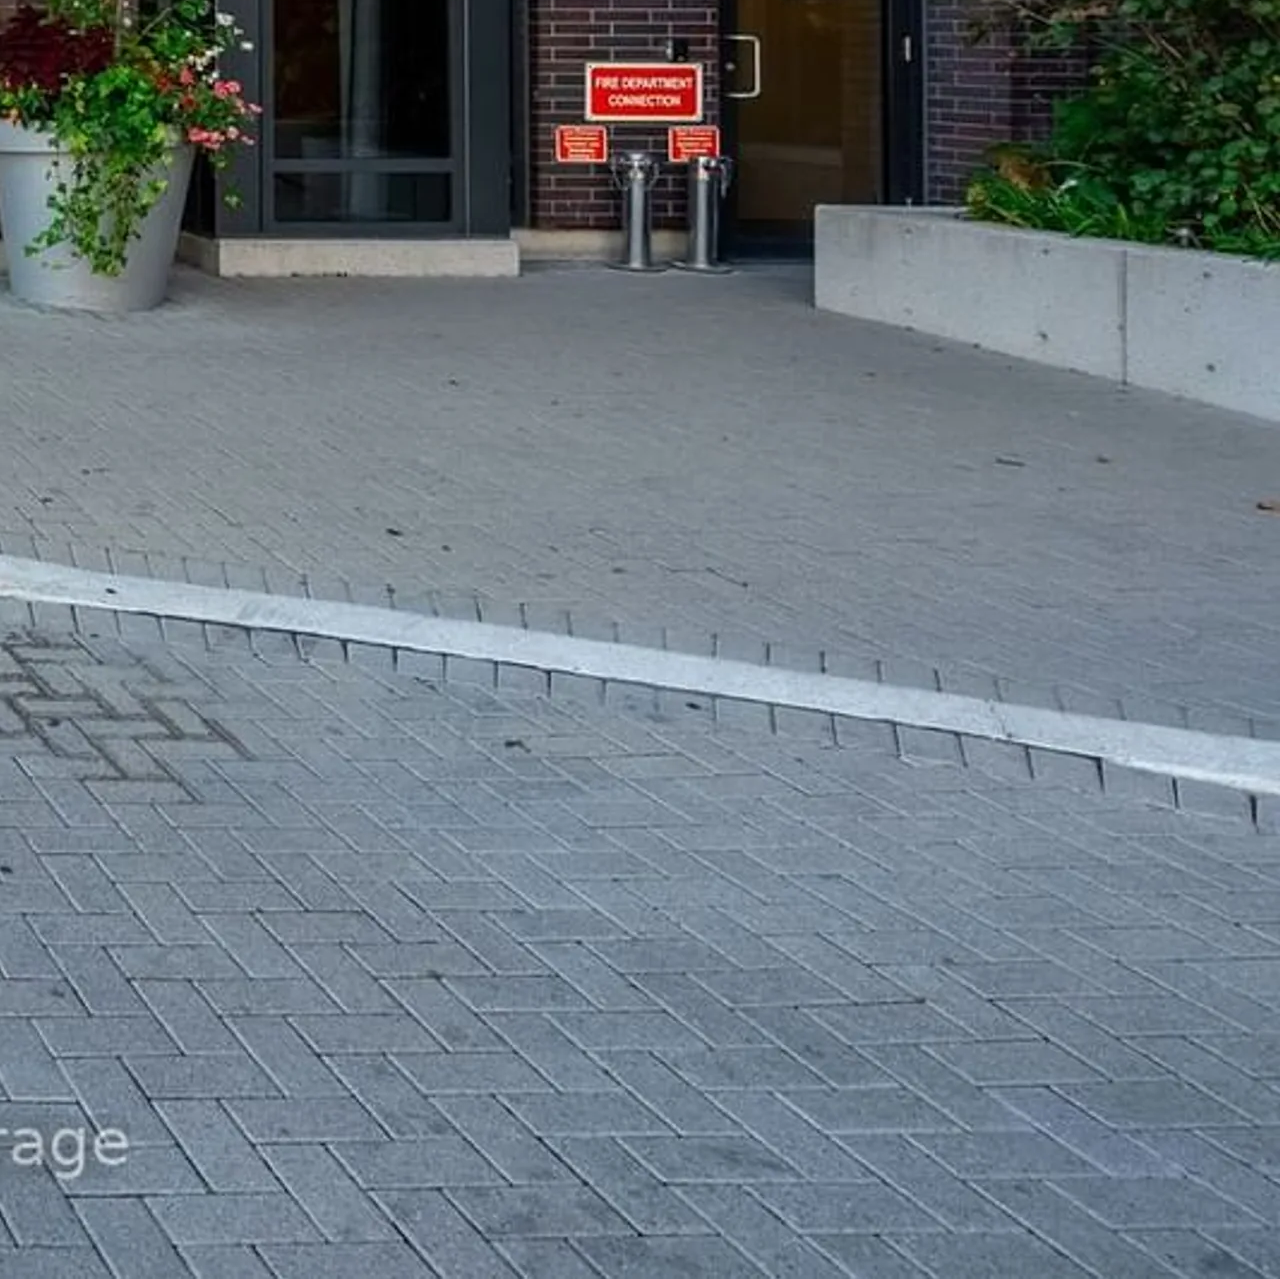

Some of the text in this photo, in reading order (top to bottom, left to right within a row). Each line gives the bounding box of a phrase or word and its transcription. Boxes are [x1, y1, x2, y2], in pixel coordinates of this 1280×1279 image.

[595, 77, 693, 88] FIRE DEPARTMENT
[608, 94, 682, 107] CONNECTION
